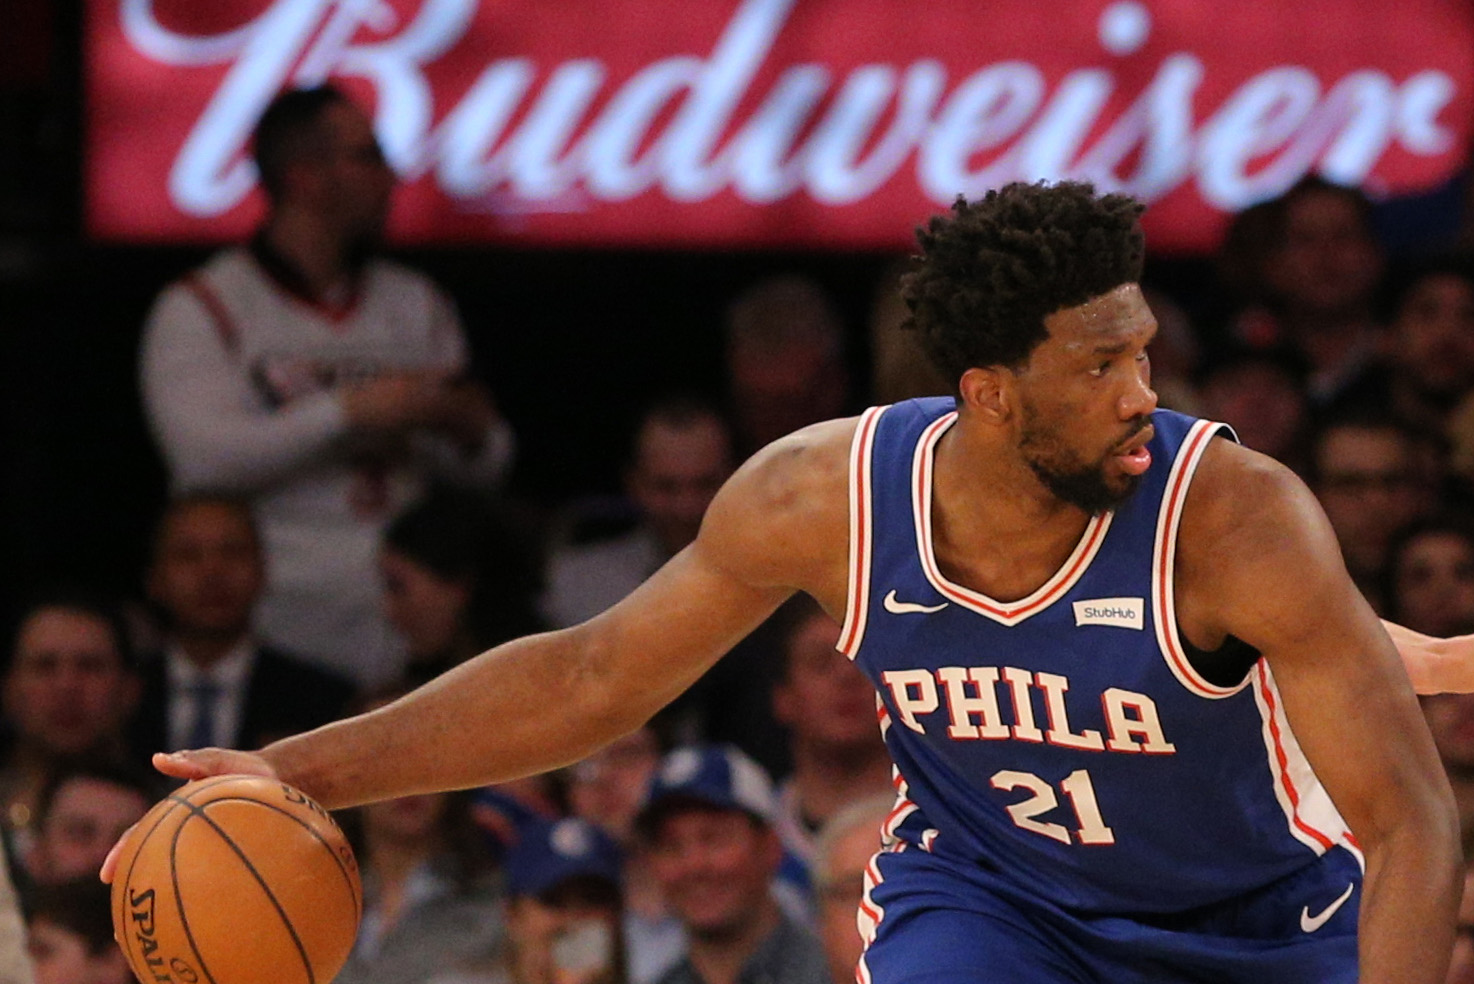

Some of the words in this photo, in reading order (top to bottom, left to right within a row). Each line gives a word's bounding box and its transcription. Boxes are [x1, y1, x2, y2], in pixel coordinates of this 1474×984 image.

[119, 0, 1456, 217] Budweiser
[1083, 606, 1136, 620] StubHub
[881, 665, 1177, 756] PHILA
[989, 768, 1116, 846] 21
